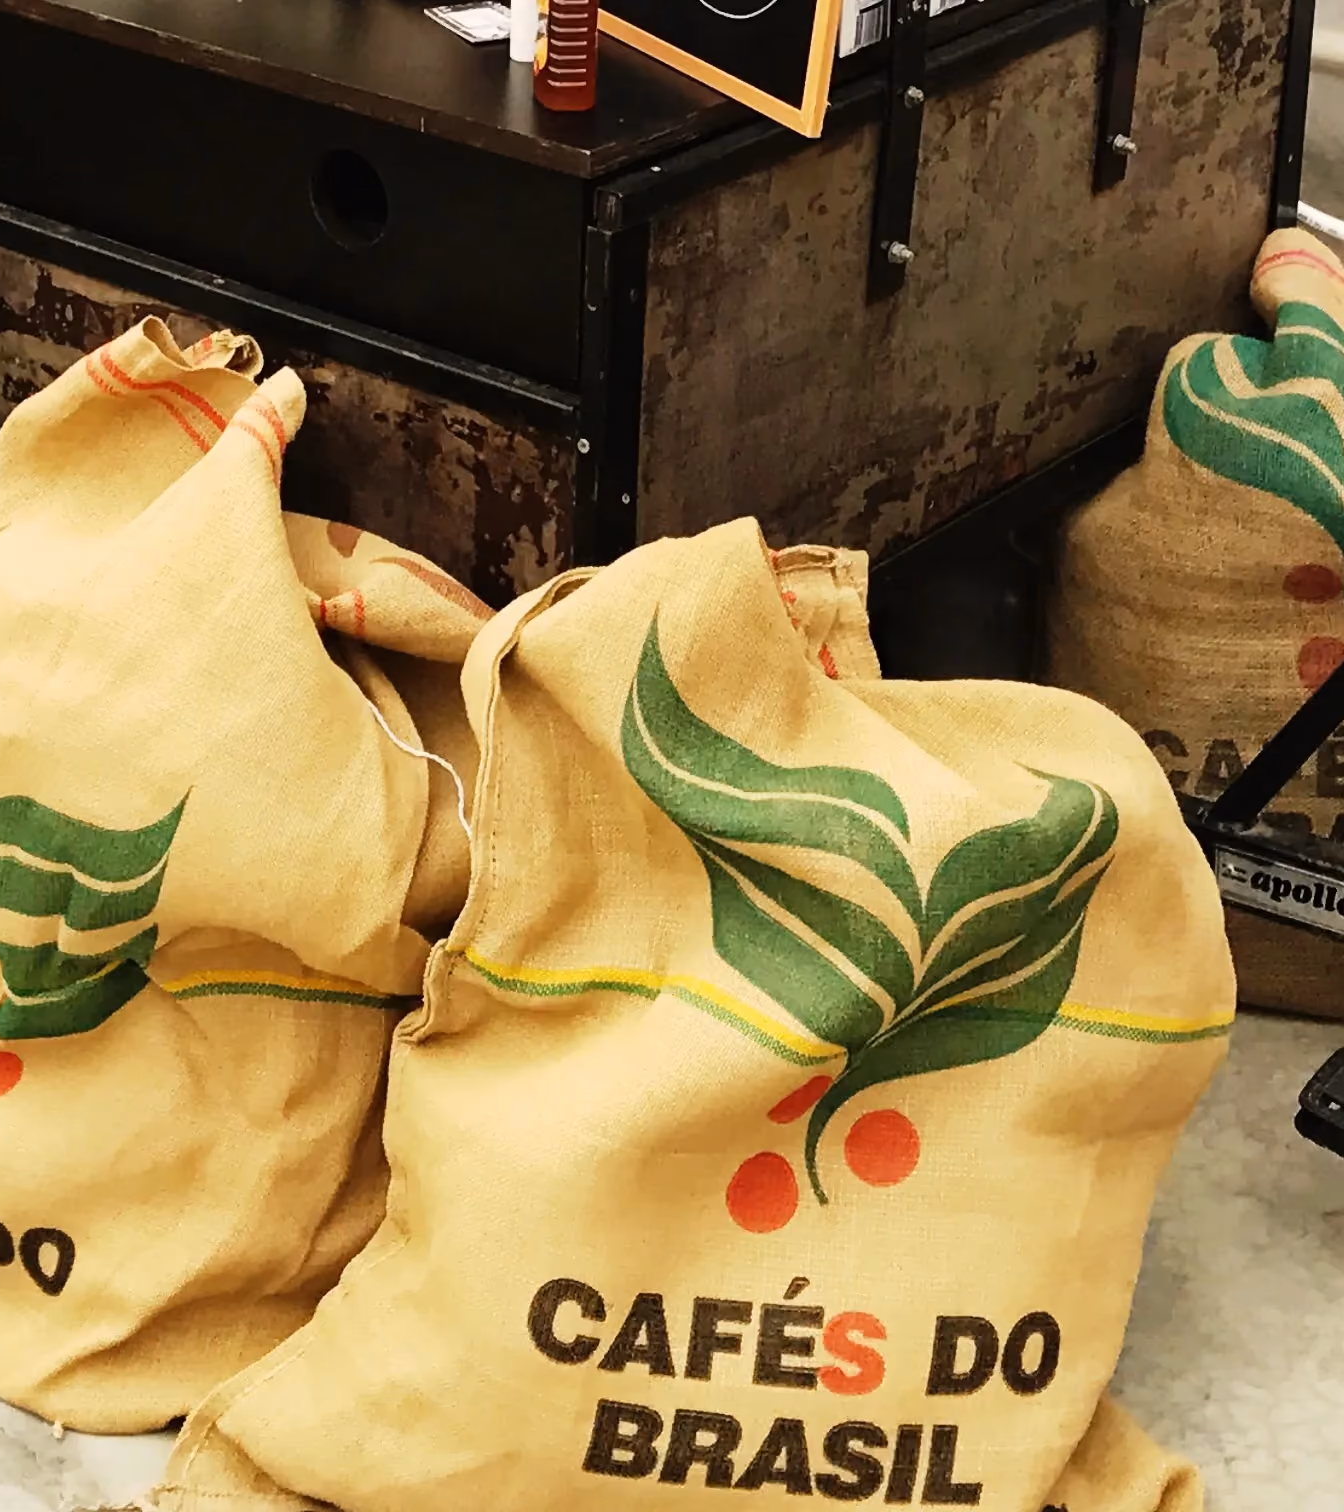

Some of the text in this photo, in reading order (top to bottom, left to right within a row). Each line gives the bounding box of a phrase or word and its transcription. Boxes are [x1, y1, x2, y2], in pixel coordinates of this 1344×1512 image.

[526, 1276, 1062, 1398] CAFÉS DO
[581, 1397, 984, 1506] BRASIL
